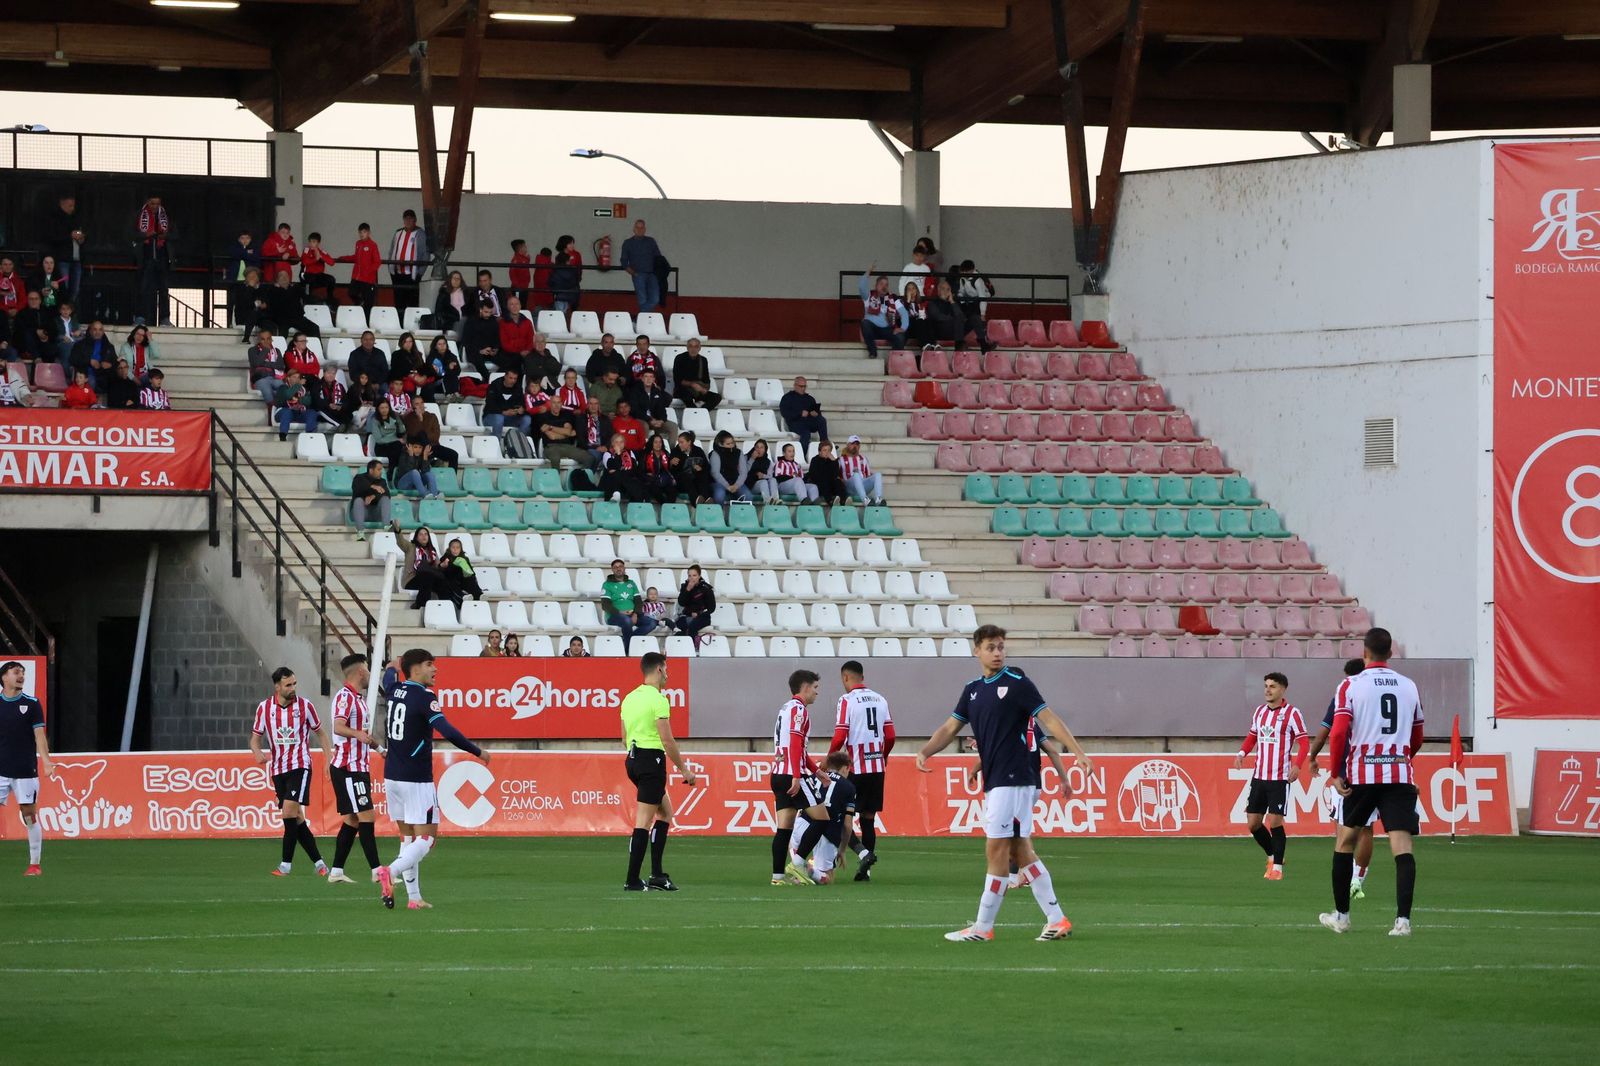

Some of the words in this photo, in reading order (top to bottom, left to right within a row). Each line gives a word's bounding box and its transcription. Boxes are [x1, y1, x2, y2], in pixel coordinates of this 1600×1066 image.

[1515, 263, 1564, 274] BODEGA
[1512, 377, 1600, 398] MONTE
[0, 425, 175, 447] STRUCCIONES
[0, 451, 129, 487] AMAR,
[140, 471, 175, 487] S.A.
[1374, 678, 1399, 686] ESLAVA
[387, 700, 407, 741] 18
[866, 707, 879, 738] 4
[1381, 693, 1398, 735] 9
[143, 764, 277, 793] Escuel
[353, 781, 367, 796] 10
[500, 779, 538, 794] COPE
[945, 760, 1106, 795] FUCÓN
[501, 796, 564, 810] ZAMORA
[571, 790, 621, 805] COPE.es
[148, 799, 285, 831] infant
[502, 811, 524, 820] 1269
[947, 800, 1107, 833] ZARACF
